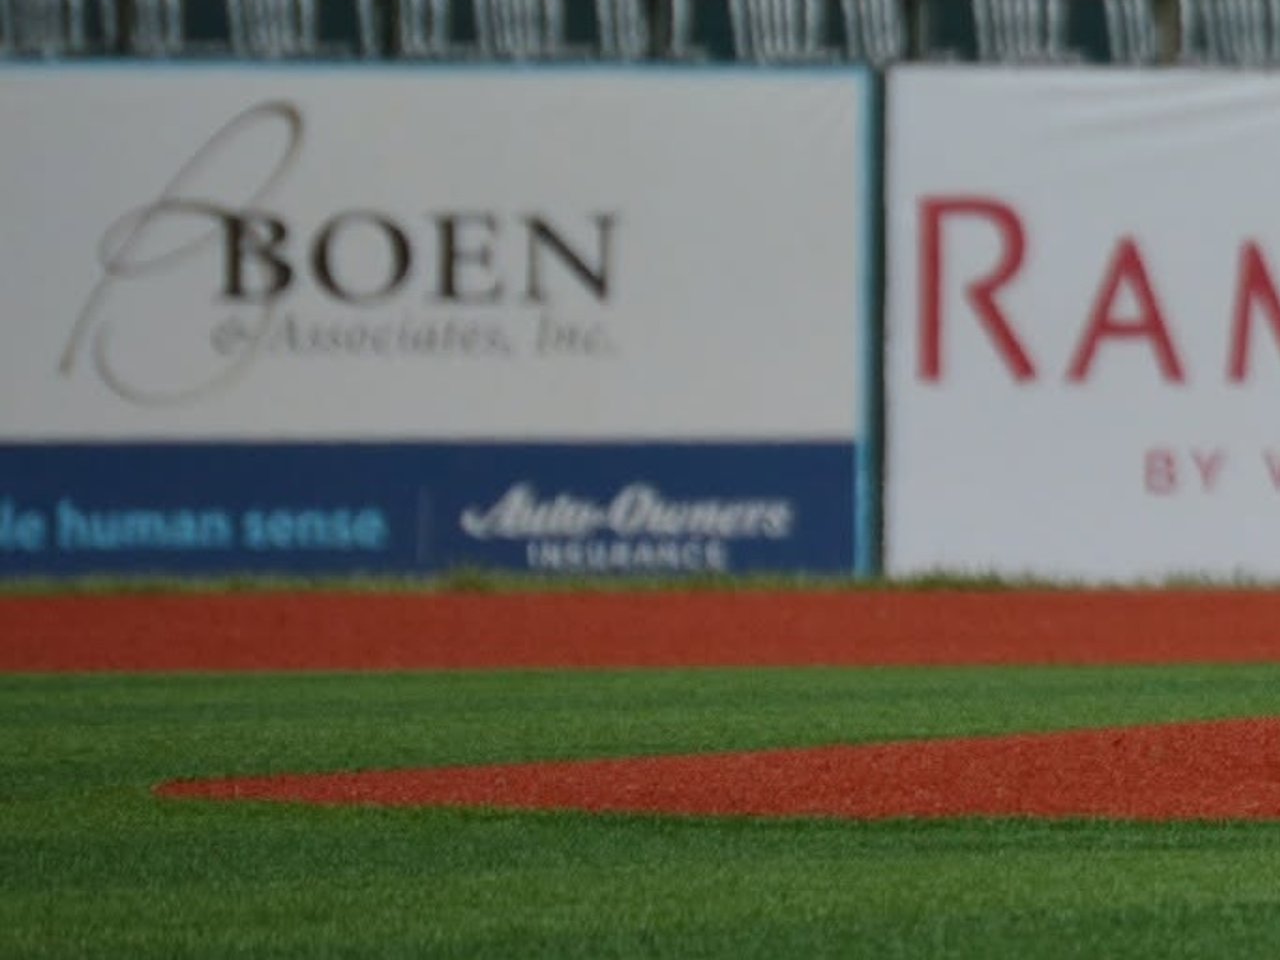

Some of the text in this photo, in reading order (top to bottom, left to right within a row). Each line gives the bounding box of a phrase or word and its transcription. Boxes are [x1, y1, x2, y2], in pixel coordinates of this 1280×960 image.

[218, 213, 616, 306] BOEN
[1145, 452, 1220, 493] BY
[57, 498, 232, 550] human
[243, 510, 388, 550] sense
[460, 485, 792, 538] Auto-Owners
[527, 541, 728, 569] INSURANCE
